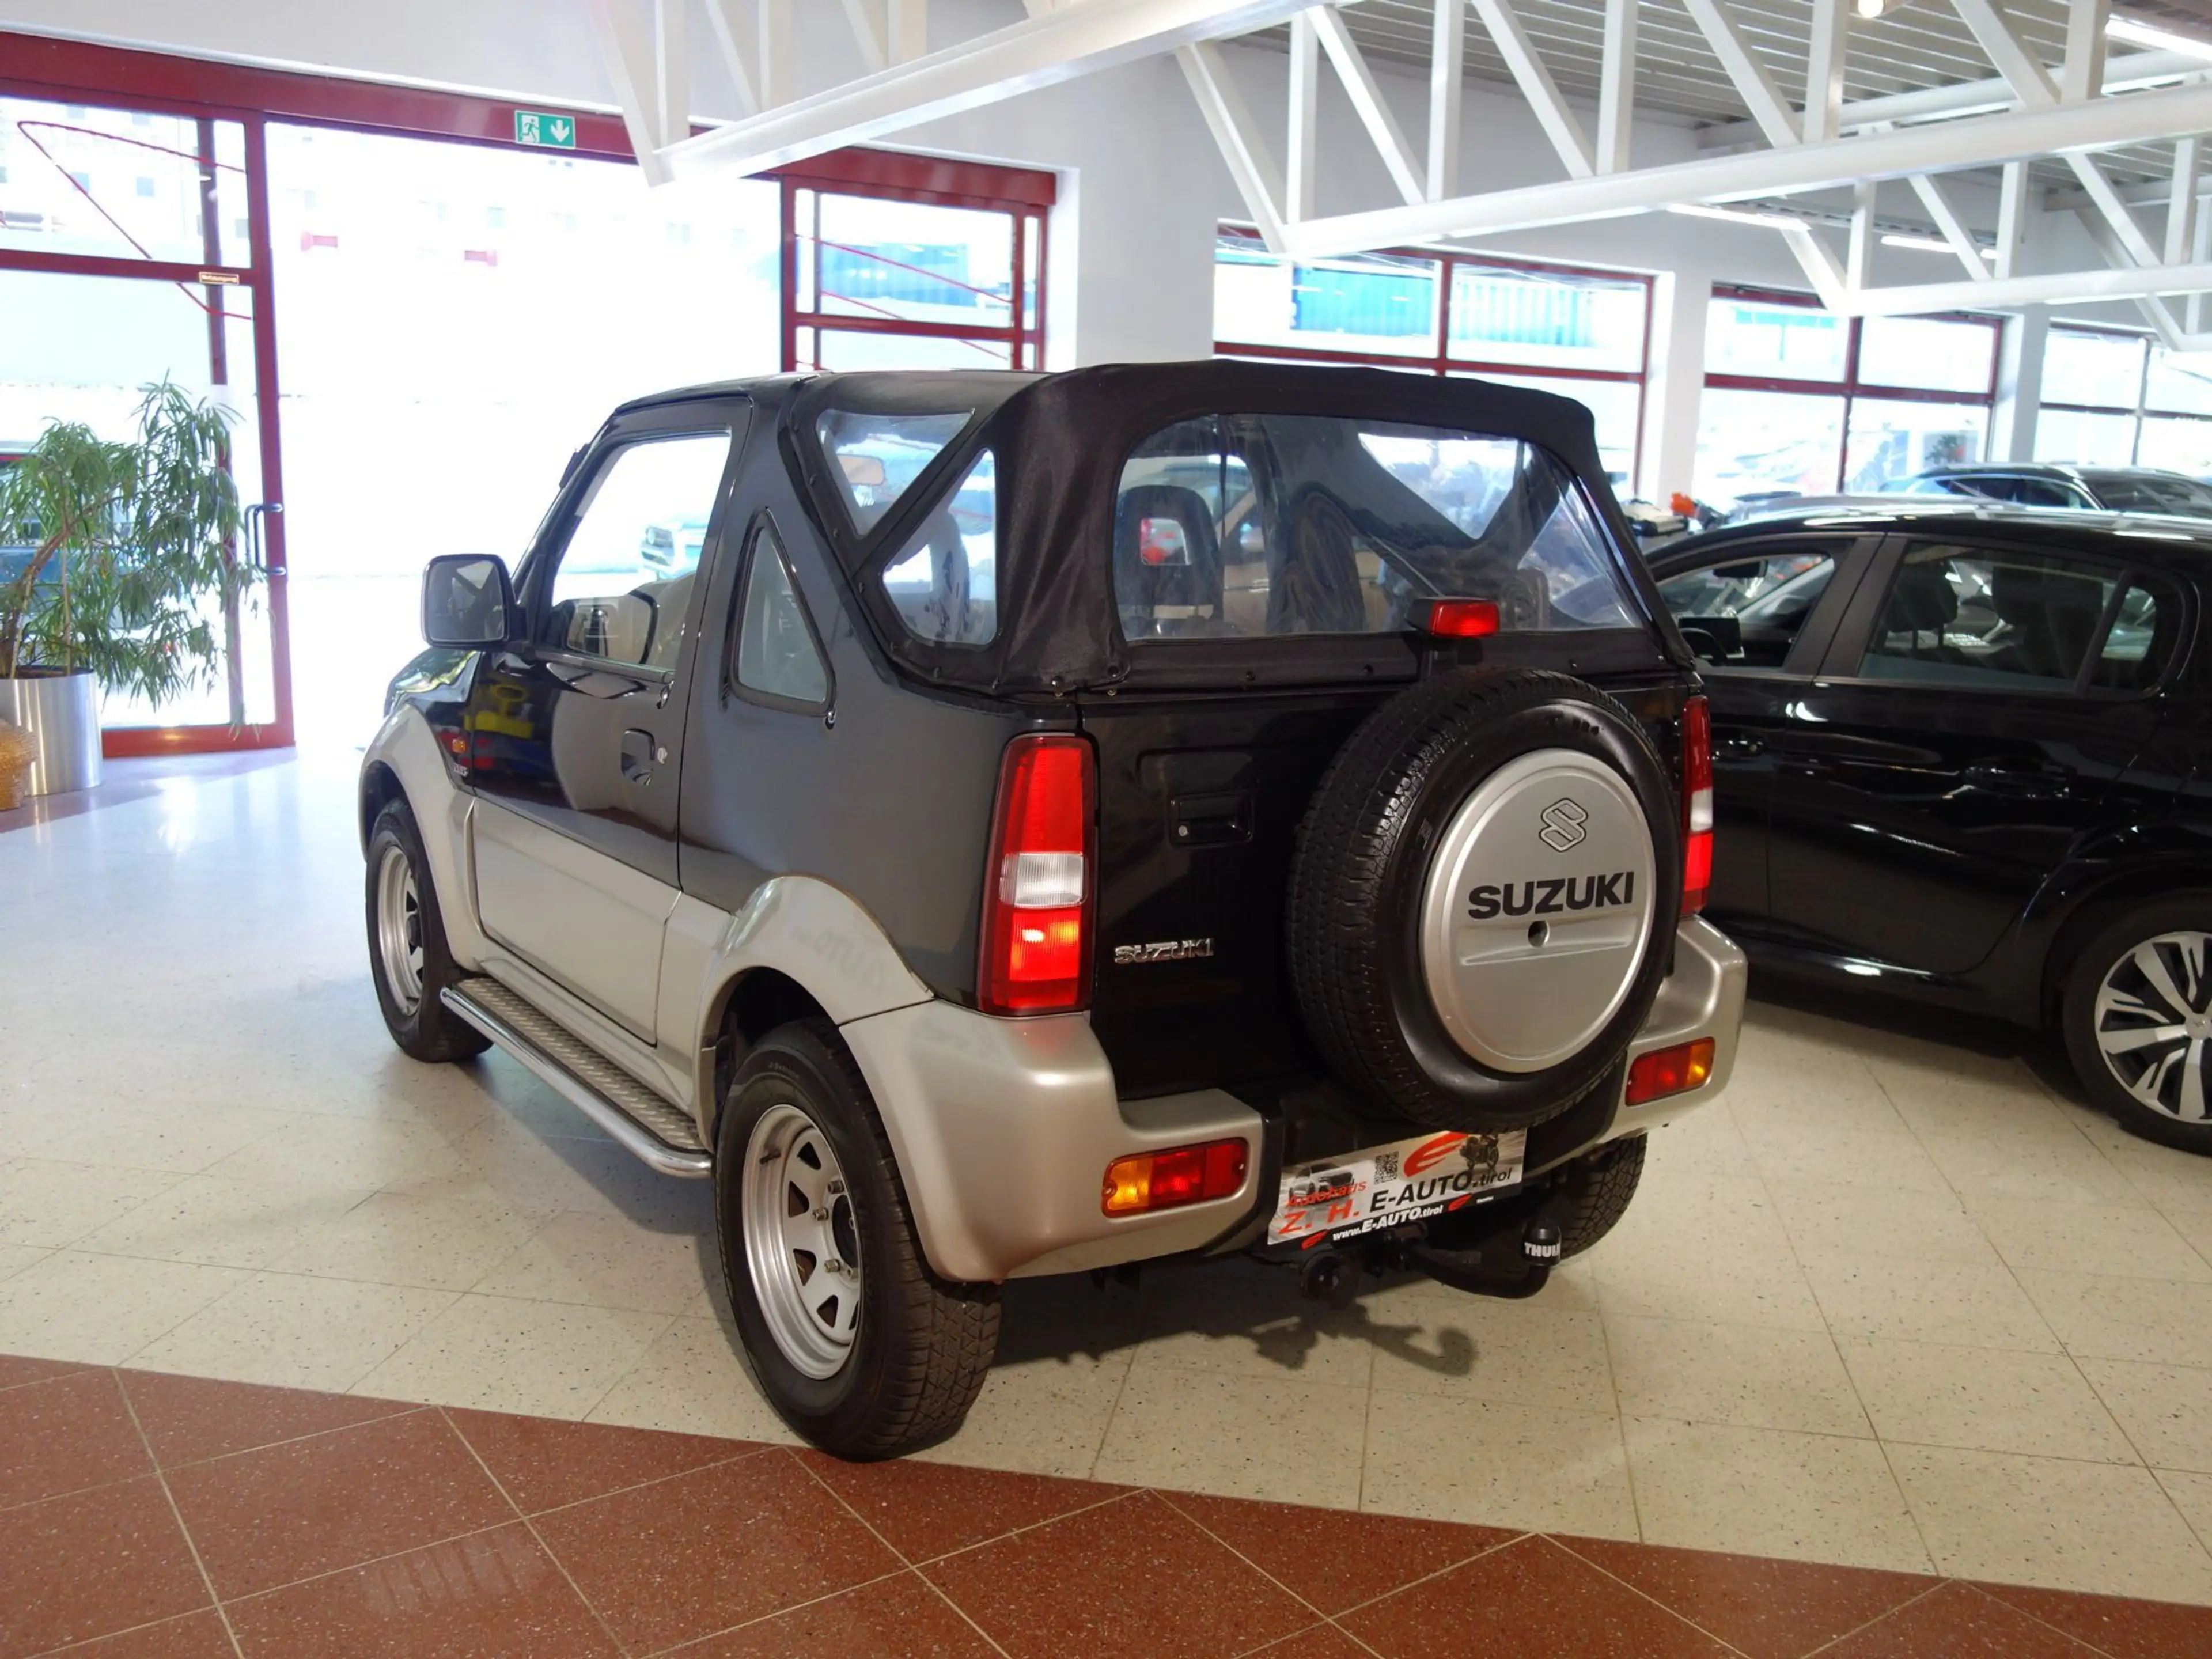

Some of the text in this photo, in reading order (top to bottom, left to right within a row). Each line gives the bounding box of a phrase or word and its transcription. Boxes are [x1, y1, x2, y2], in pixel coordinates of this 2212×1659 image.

[1468, 871, 1635, 919] SUZUKI
[1114, 937, 1214, 964] SUZUKI
[1369, 1167, 1513, 1213] E-AUTO.tirol
